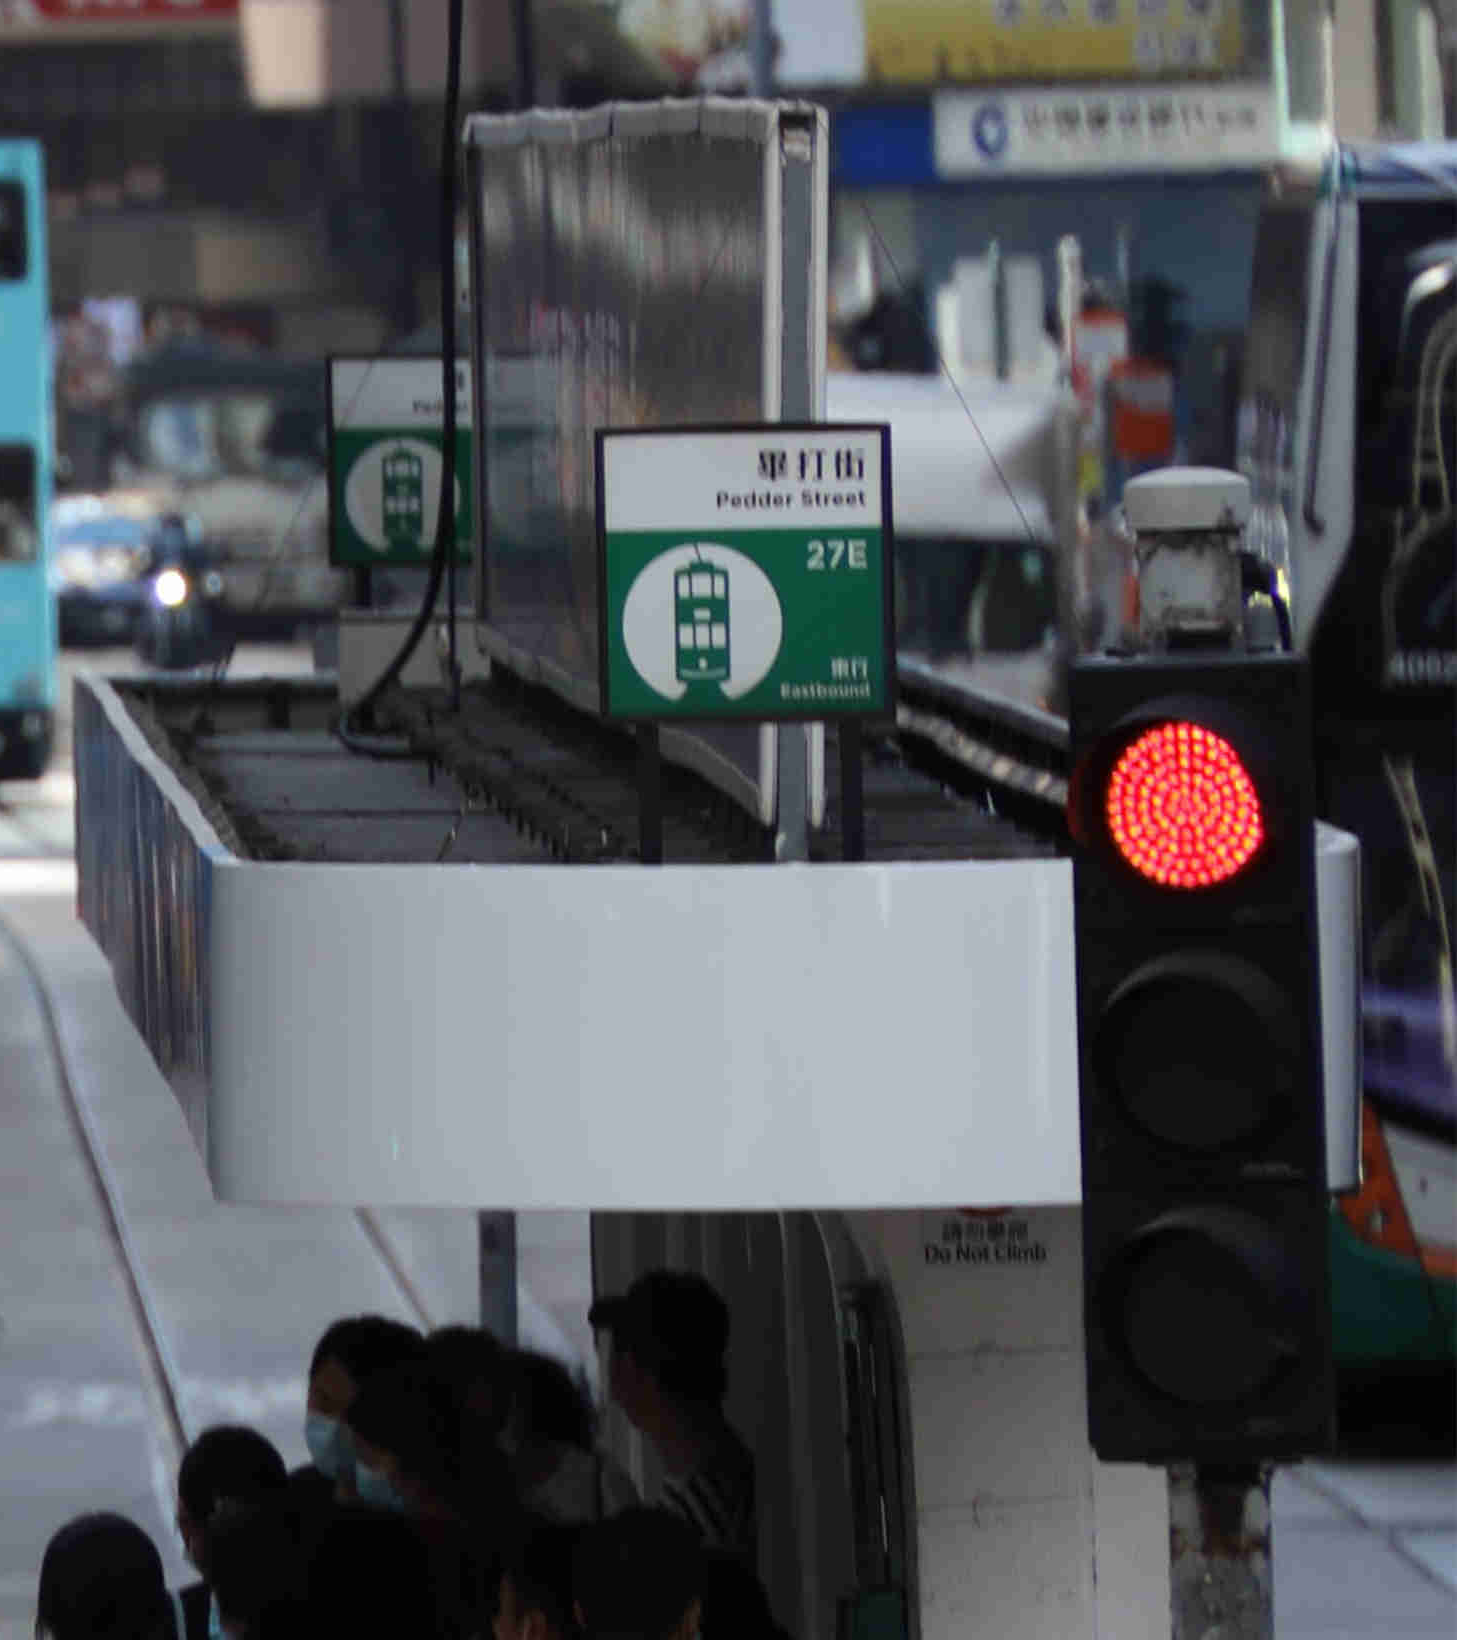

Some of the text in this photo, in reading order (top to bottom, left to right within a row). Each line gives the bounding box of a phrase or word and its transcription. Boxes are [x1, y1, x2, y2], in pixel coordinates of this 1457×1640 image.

[717, 490, 866, 509] Pedder Street
[807, 539, 867, 570] 27E
[781, 681, 870, 700] Eastbound
[924, 1242, 1047, 1264] Do Not Climb
